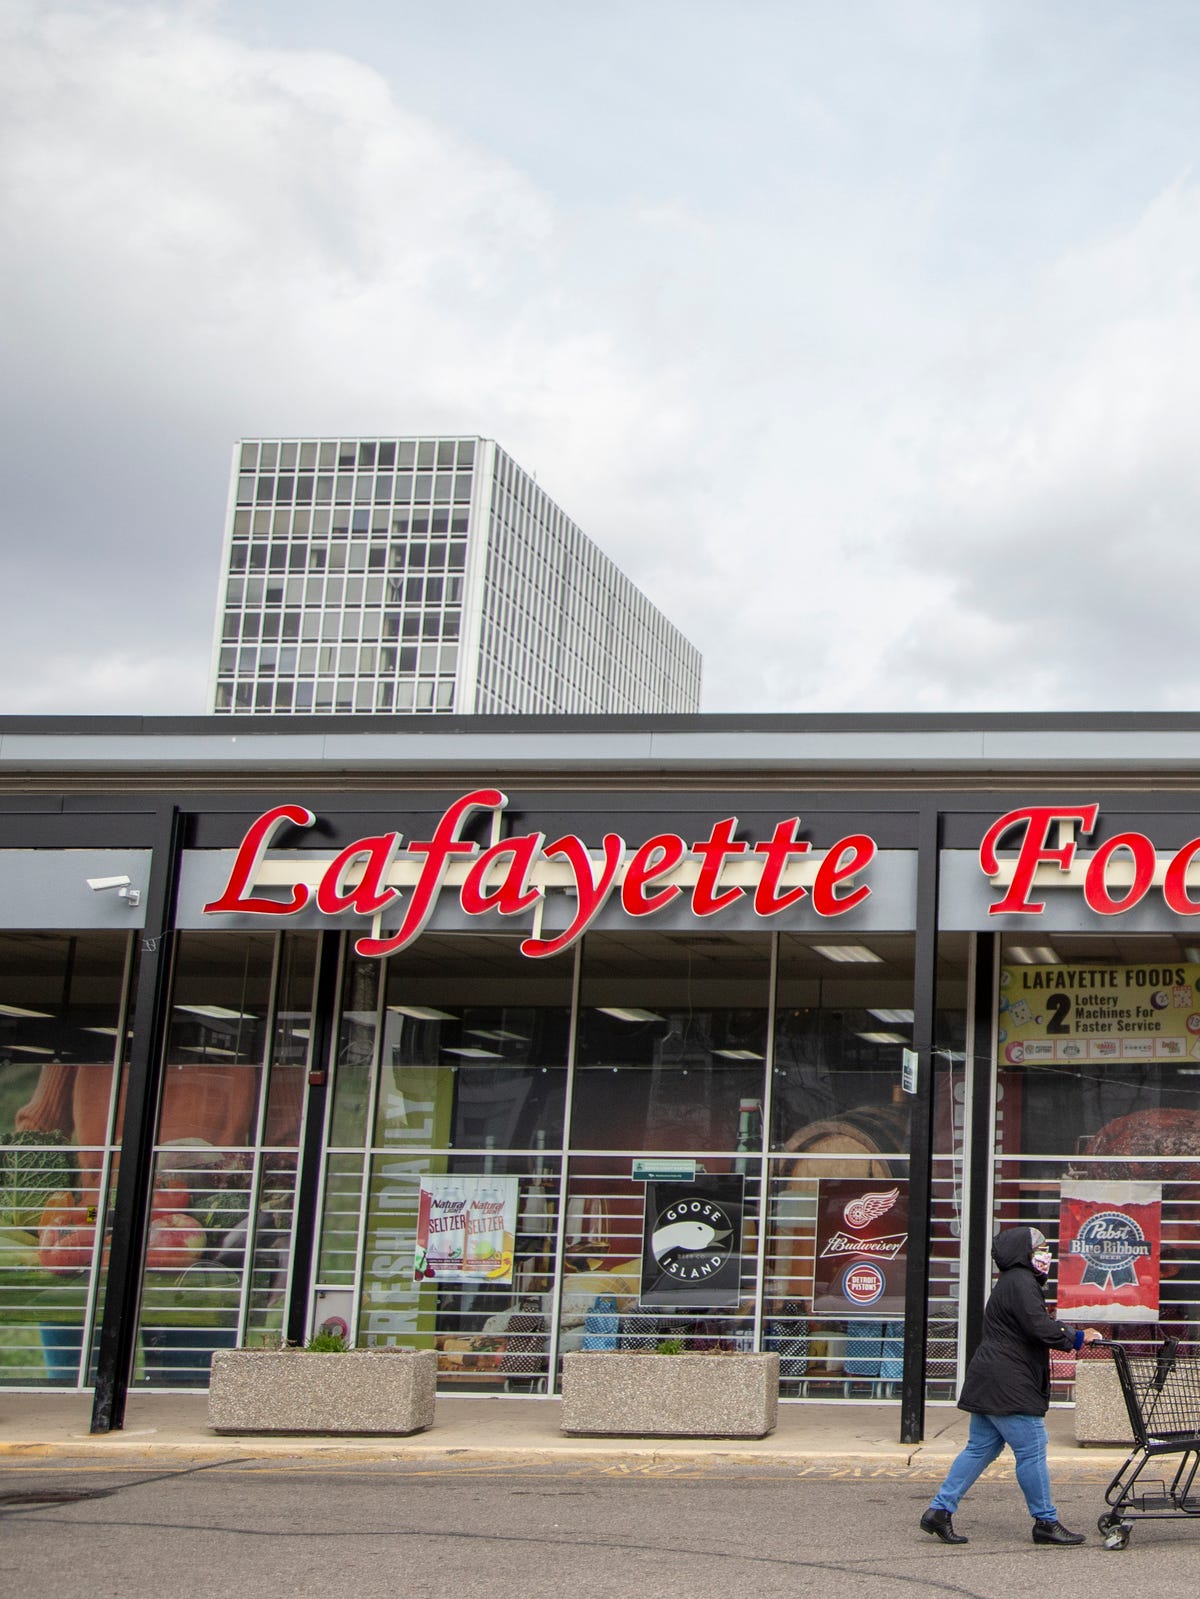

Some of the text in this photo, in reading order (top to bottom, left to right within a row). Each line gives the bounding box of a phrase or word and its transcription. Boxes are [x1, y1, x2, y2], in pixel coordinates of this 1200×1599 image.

[202, 789, 877, 957] Lafayette
[1023, 970, 1118, 989] LAFAYETTE
[1125, 968, 1185, 987] FOODS
[1075, 995, 1118, 1008] Lottery
[1046, 993, 1071, 1034] 2
[1075, 1006, 1154, 1019] Machines For
[1075, 1019, 1161, 1033] Faster Service
[431, 1200, 466, 1210] Natural
[470, 1200, 505, 1211] Natural
[667, 1202, 721, 1222] GOOSE
[429, 1214, 466, 1234] SELTZER
[467, 1215, 504, 1235] SELTZER
[1089, 1221, 1131, 1240] Pabst
[828, 1238, 900, 1251] Budweiser
[1071, 1240, 1149, 1256] Blue Ribbon
[663, 1256, 721, 1278] ISLAND
[852, 1276, 877, 1284] DETROIT
[852, 1283, 877, 1291] PISTONS
